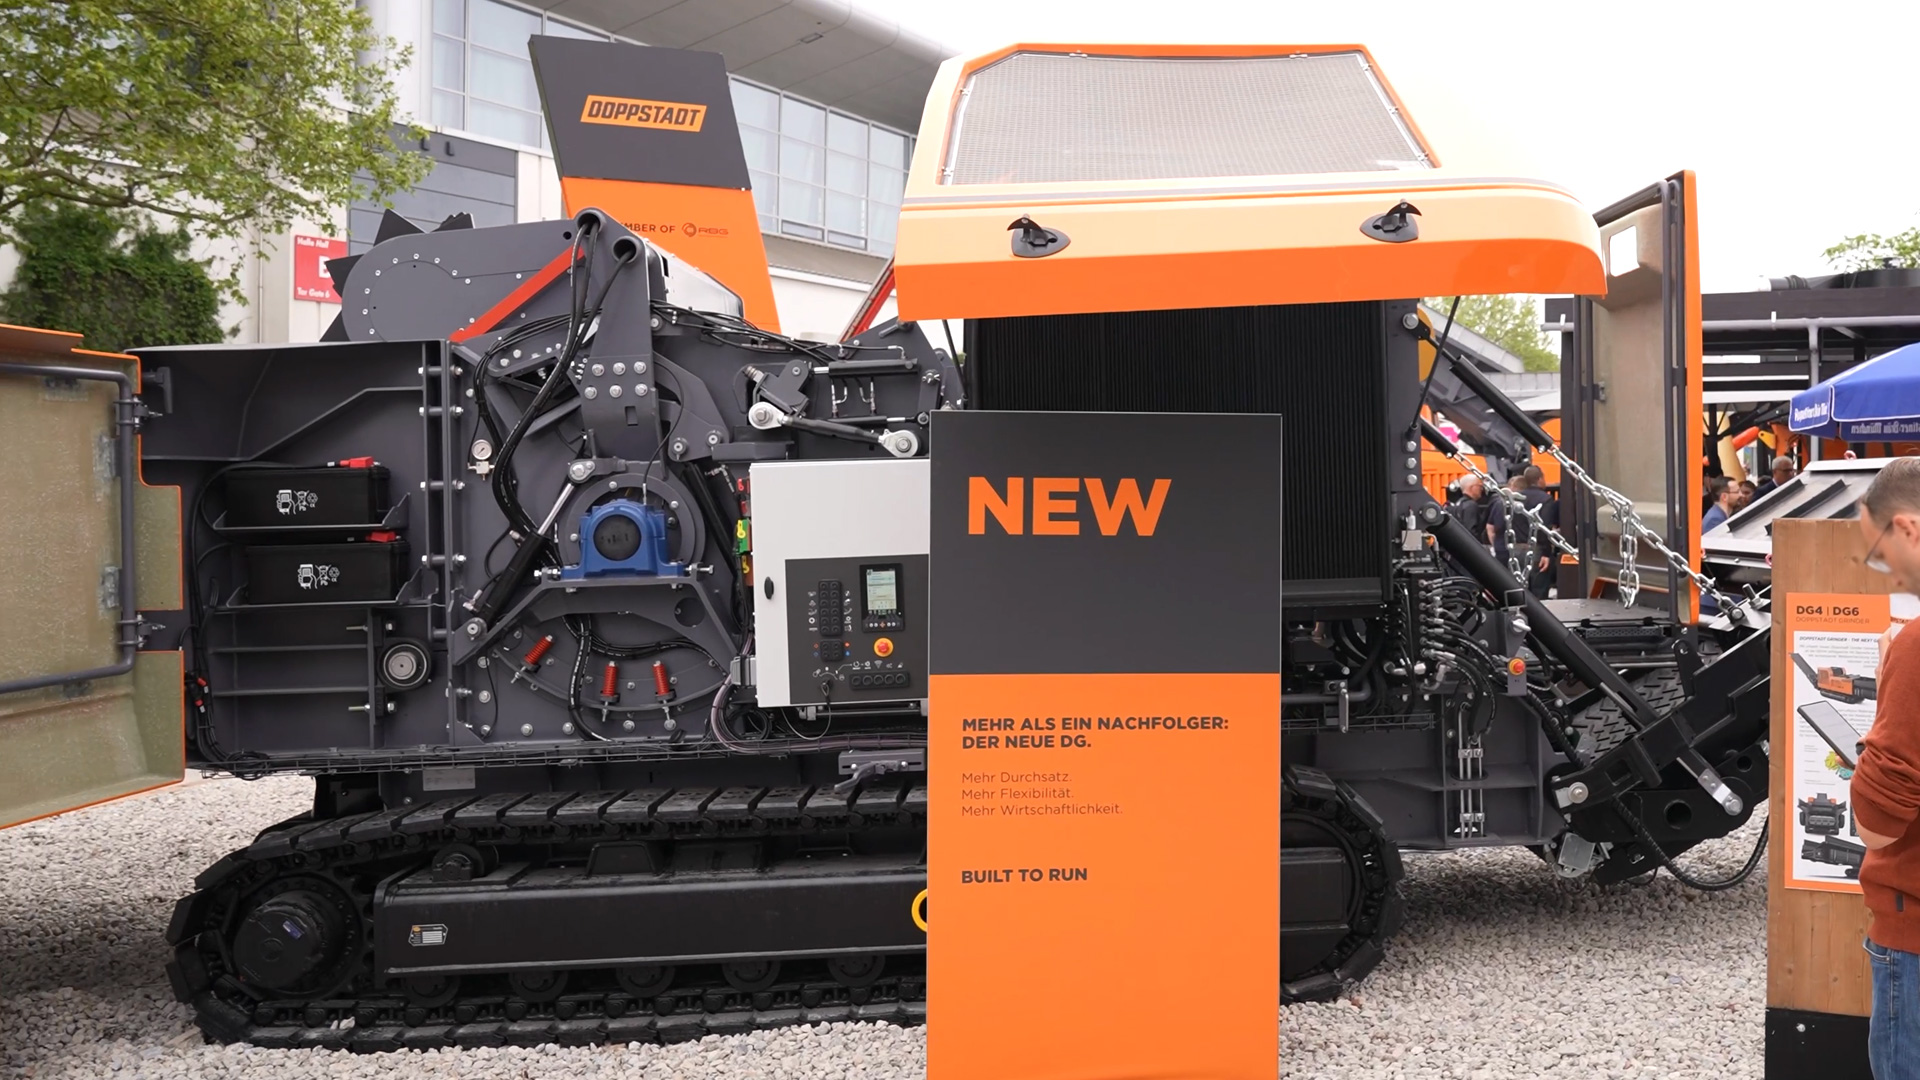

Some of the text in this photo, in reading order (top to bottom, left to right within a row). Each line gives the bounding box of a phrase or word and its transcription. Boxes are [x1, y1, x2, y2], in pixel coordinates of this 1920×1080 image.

[587, 100, 701, 127] DOPPSTADT
[621, 223, 675, 233] MBER OF
[297, 287, 330, 298] Tor Gate 6
[969, 477, 1171, 536] NEW
[1796, 605, 1823, 615] DG4
[1833, 606, 1860, 616] DG6
[963, 716, 1229, 731] MEHR ALS EIN NACHFOLGER:
[963, 734, 1092, 749] DER NEUE DG.
[962, 771, 1072, 784] Mehr Durchsatz.
[962, 787, 1074, 800] Mehr Flexibilität.
[962, 803, 1123, 817] Mehr Wirtschaftlichkeit.
[962, 867, 1087, 883] BUILT TO RUN
